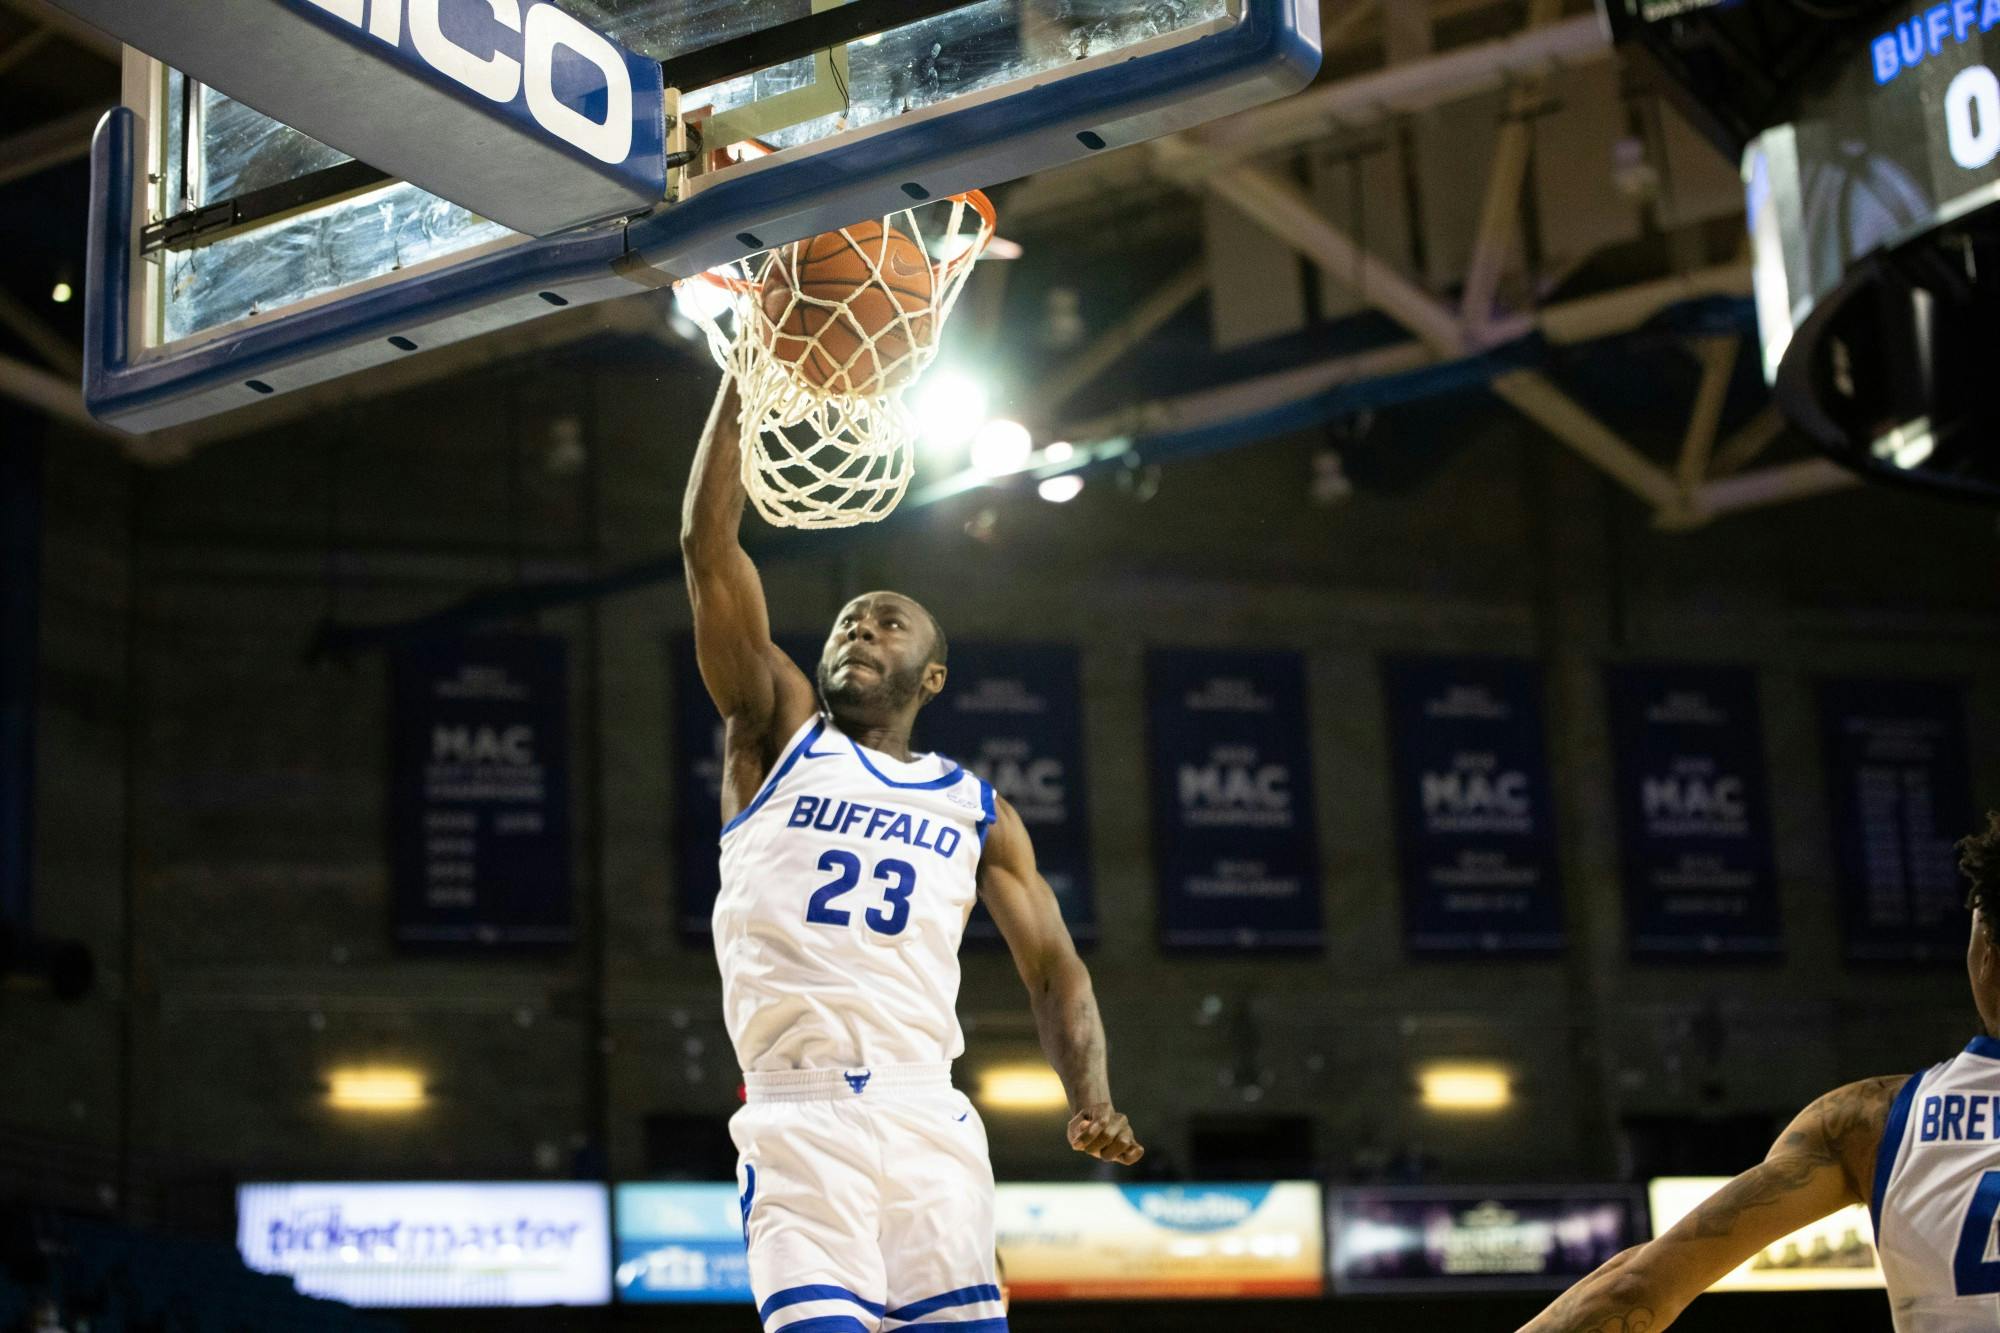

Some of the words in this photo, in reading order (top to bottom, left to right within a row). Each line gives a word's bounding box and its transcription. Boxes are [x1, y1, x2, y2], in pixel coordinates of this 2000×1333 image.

[306, 0, 633, 164] CO
[430, 724, 535, 765] MAC
[1176, 764, 1293, 811] MAC
[1420, 771, 1532, 818] MAC
[1641, 777, 1747, 821] MAC
[787, 795, 961, 858] BUFFALO
[806, 849, 916, 935] 23
[1920, 1094, 2000, 1142] BRE
